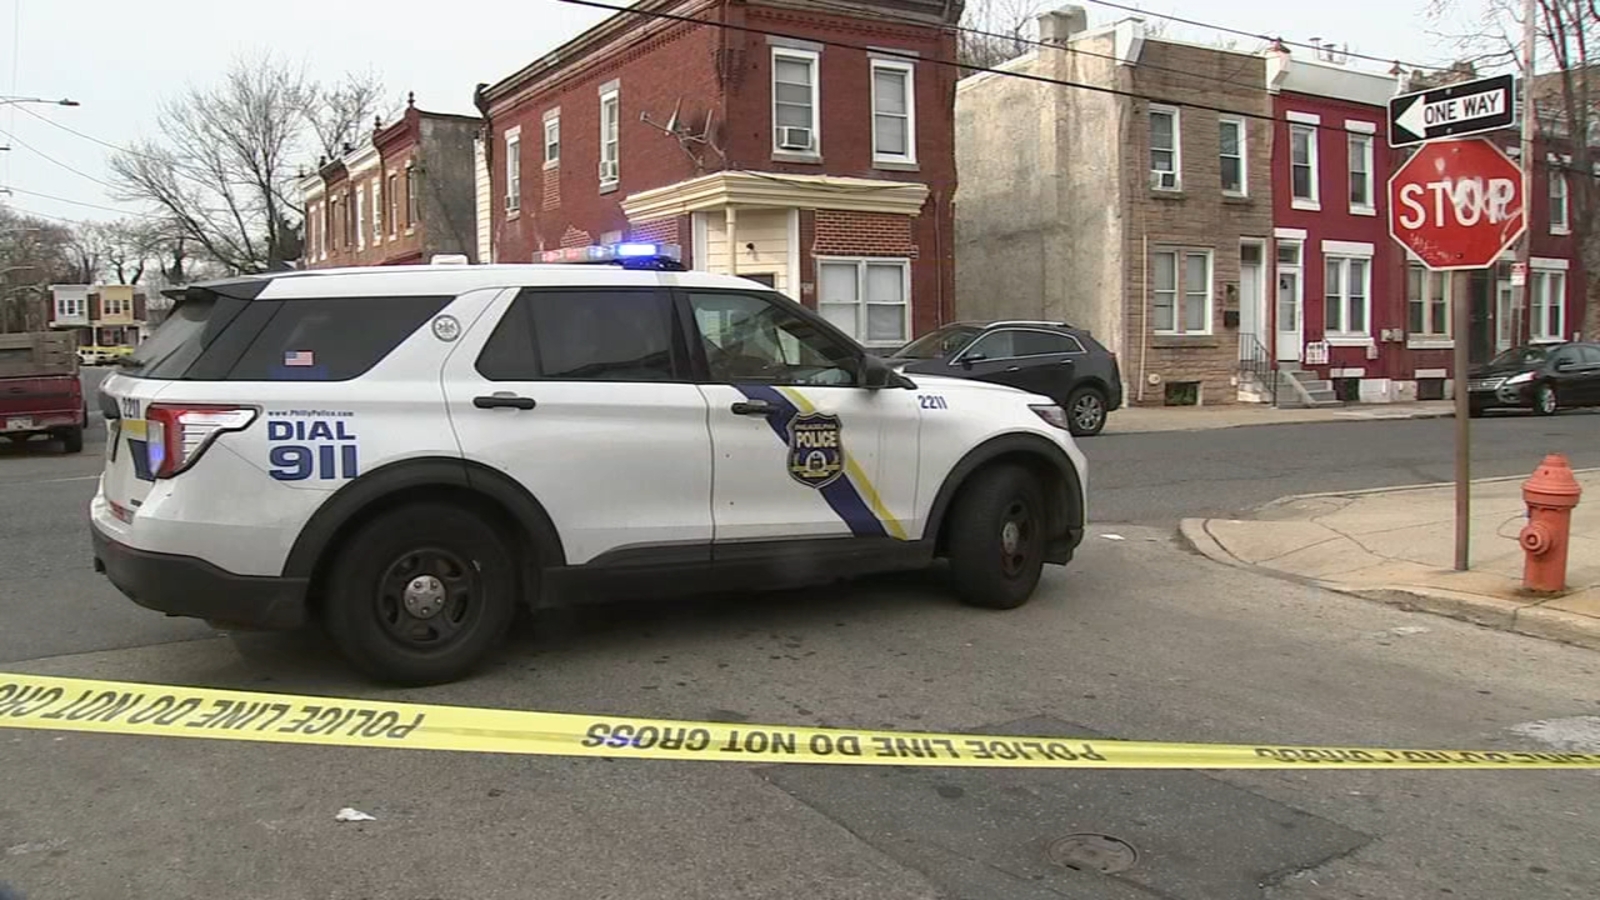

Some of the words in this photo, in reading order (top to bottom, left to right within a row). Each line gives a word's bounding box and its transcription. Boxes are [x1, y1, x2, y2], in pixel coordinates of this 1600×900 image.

[1424, 100, 1457, 125] ONE
[1463, 93, 1500, 117] WAY
[1399, 177, 1515, 230] STOP
[918, 395, 948, 409] 2211
[267, 421, 356, 440] DIAL
[795, 431, 838, 448] POLICE
[268, 444, 360, 481] 911
[43, 689, 143, 722] NOT
[127, 695, 204, 729] DO
[200, 699, 291, 730] LINE
[289, 705, 426, 739] POLICE
[580, 723, 710, 751] CROSS
[719, 730, 796, 755] NOT
[809, 734, 863, 757] DO
[872, 736, 961, 759] LINE
[965, 740, 1107, 762] POLICE
